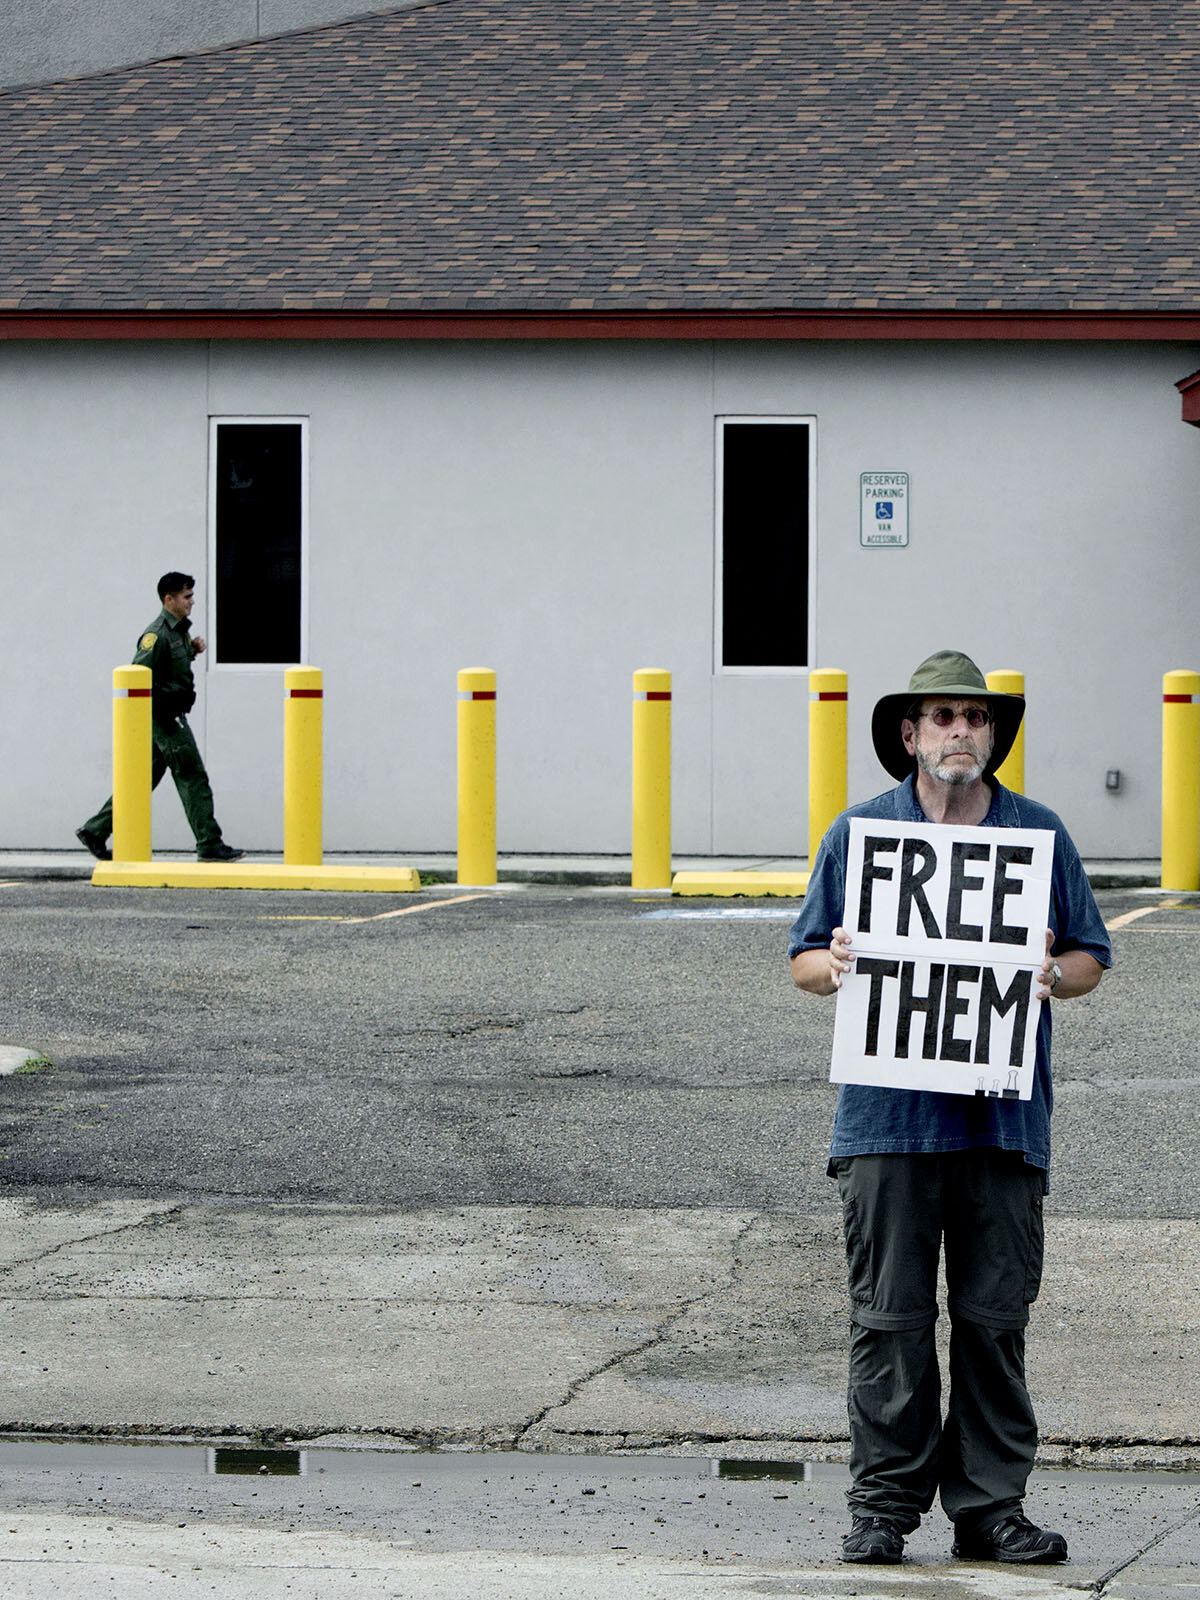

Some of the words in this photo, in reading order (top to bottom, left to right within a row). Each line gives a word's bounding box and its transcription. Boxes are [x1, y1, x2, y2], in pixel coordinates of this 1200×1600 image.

[863, 476, 906, 485] RESERVED
[866, 489, 904, 498] PARKING
[867, 535, 902, 543] ACCESSIBLE
[857, 835, 1034, 946] FREE
[856, 957, 1032, 1067] THEM
